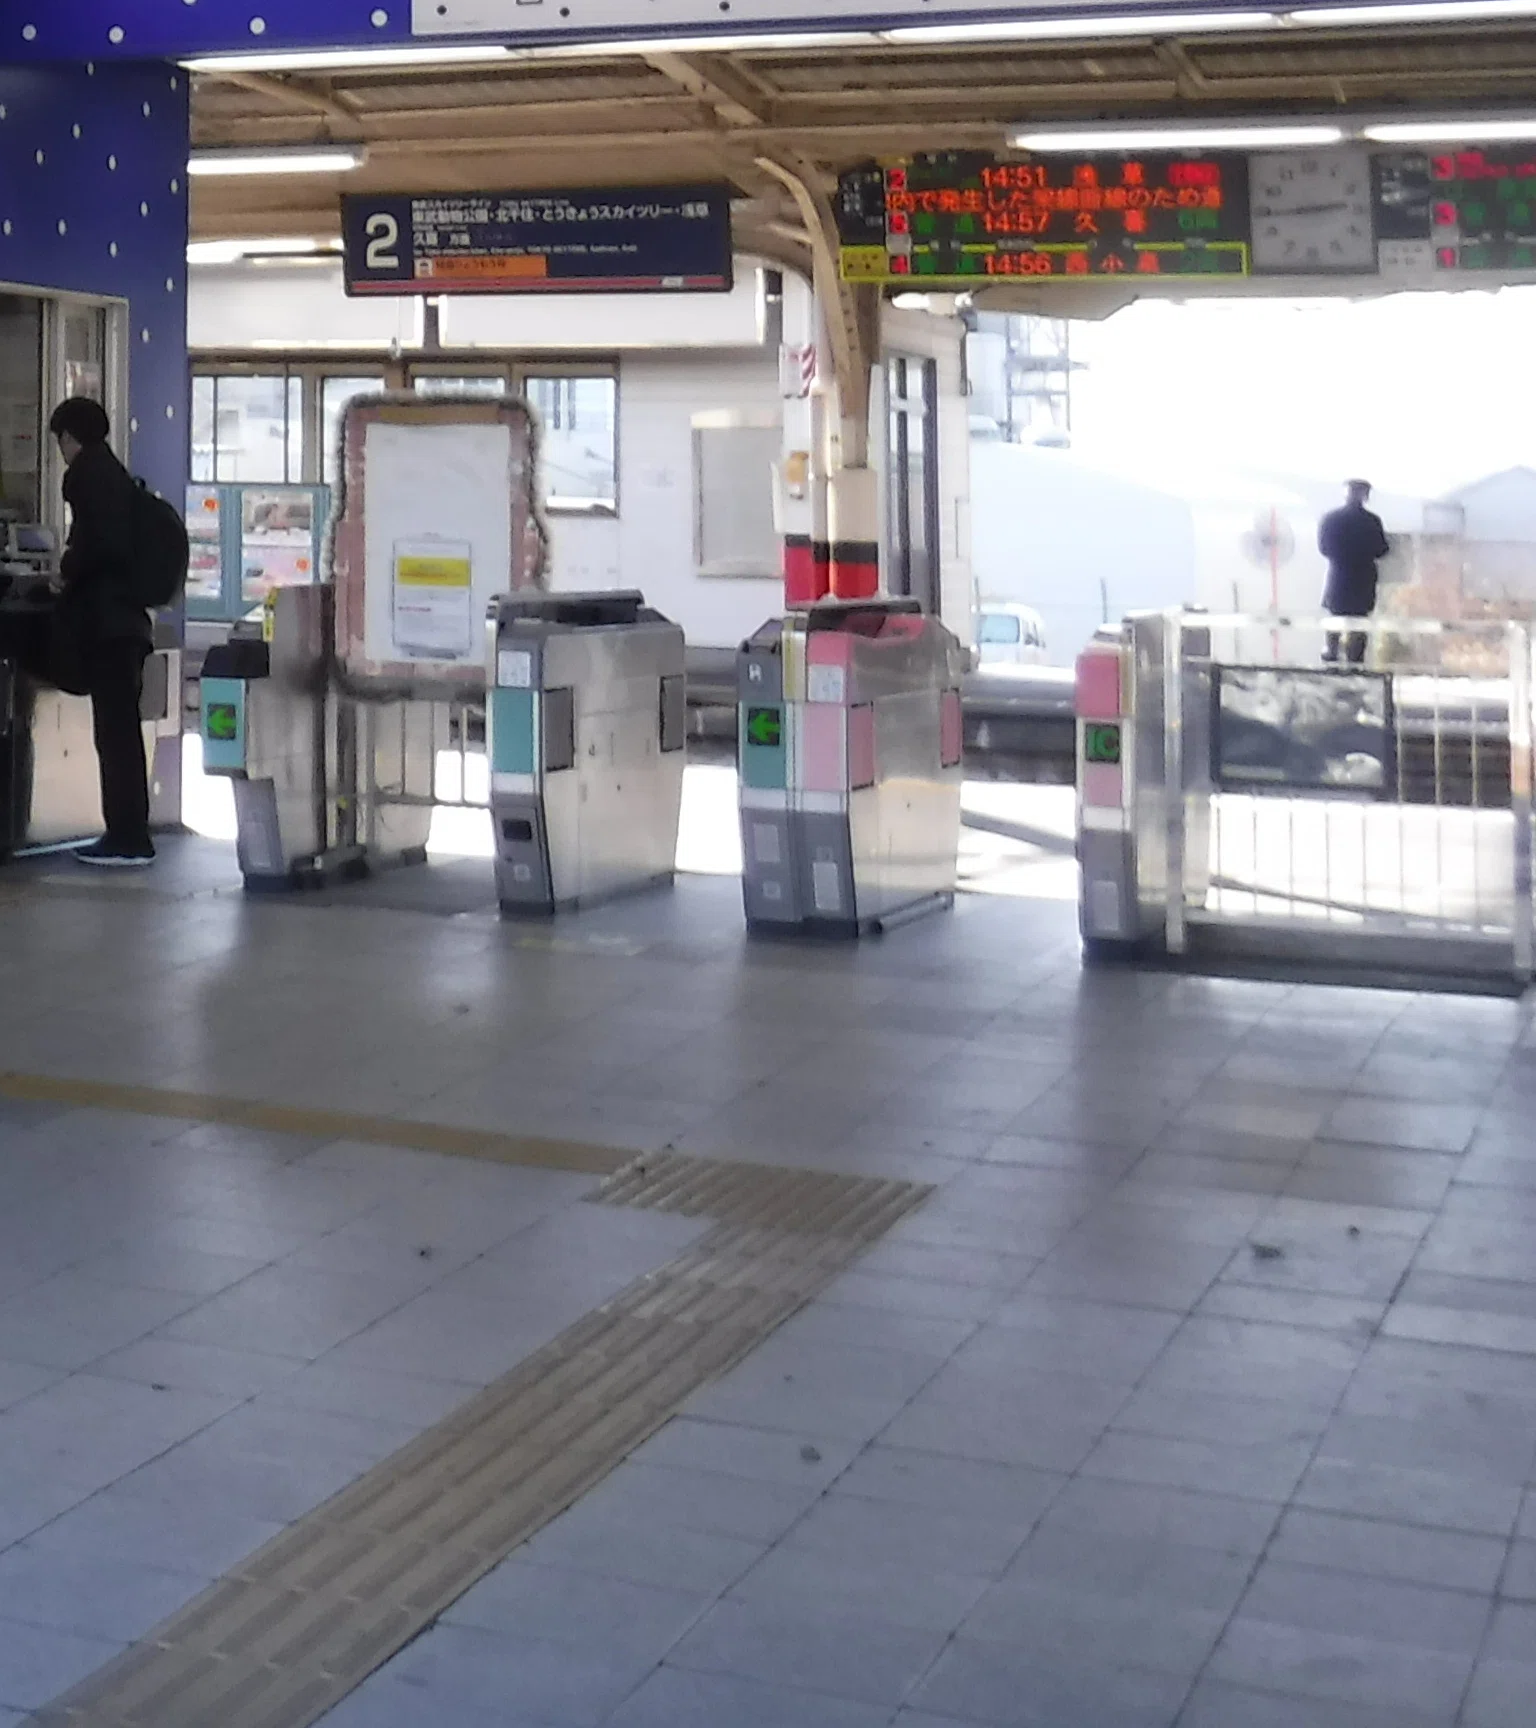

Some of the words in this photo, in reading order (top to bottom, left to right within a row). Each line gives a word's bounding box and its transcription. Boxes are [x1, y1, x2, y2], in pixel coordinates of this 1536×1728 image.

[981, 165, 1047, 188] 14:51
[984, 215, 1051, 234] 14:57
[365, 213, 400, 269] 2
